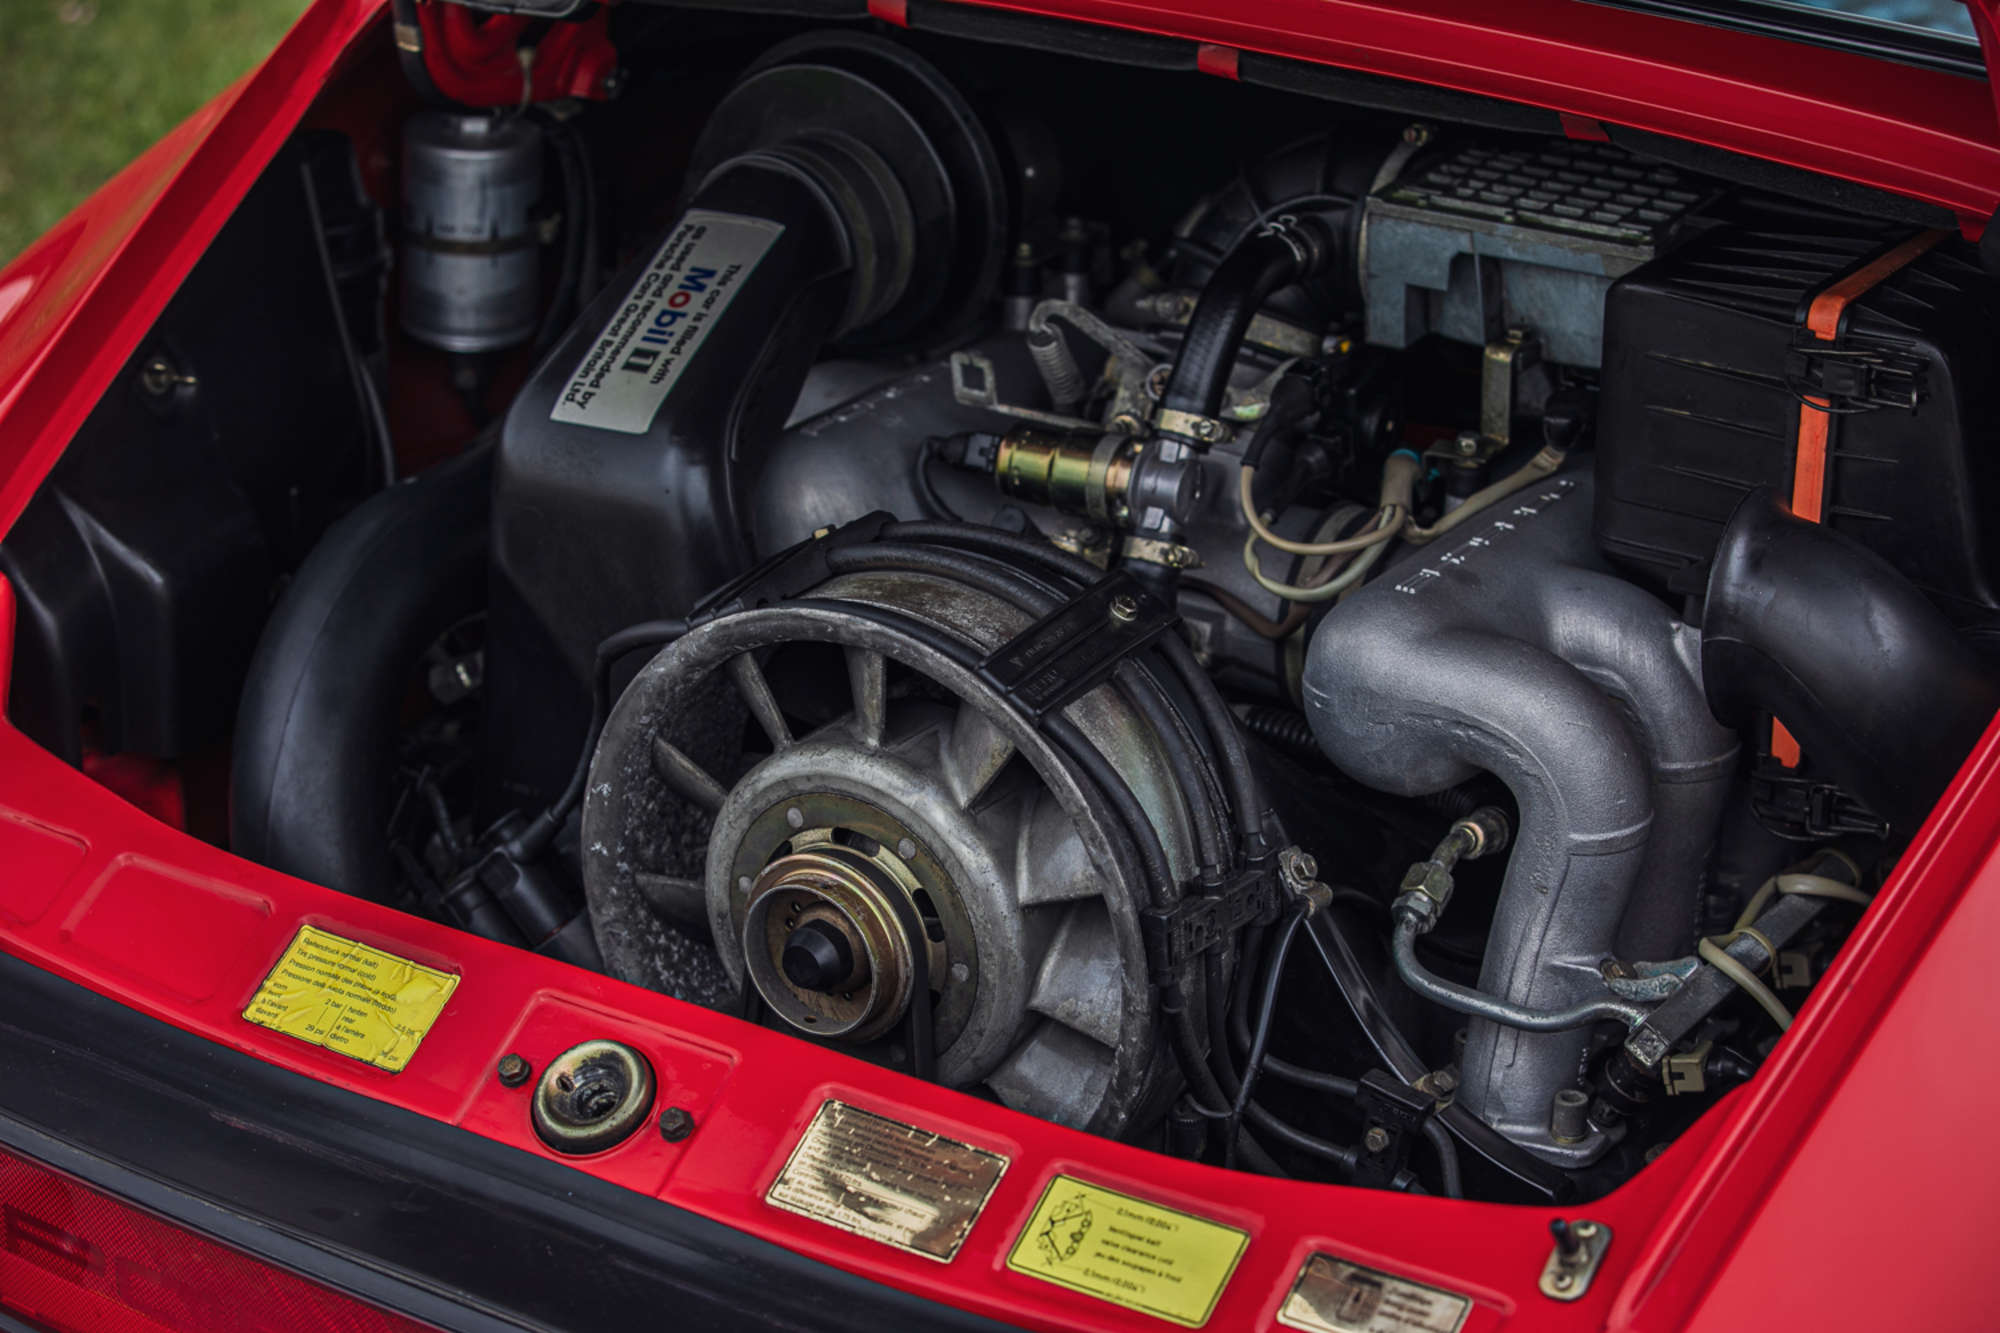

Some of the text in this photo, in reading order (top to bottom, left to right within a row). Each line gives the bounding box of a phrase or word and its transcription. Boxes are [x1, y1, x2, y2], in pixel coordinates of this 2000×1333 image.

[559, 223, 695, 406] Porsche Cars Great Britain Ltd.
[571, 225, 708, 410] as used and recommended by
[639, 264, 719, 345] Mobil
[647, 262, 743, 385] This car is filled with
